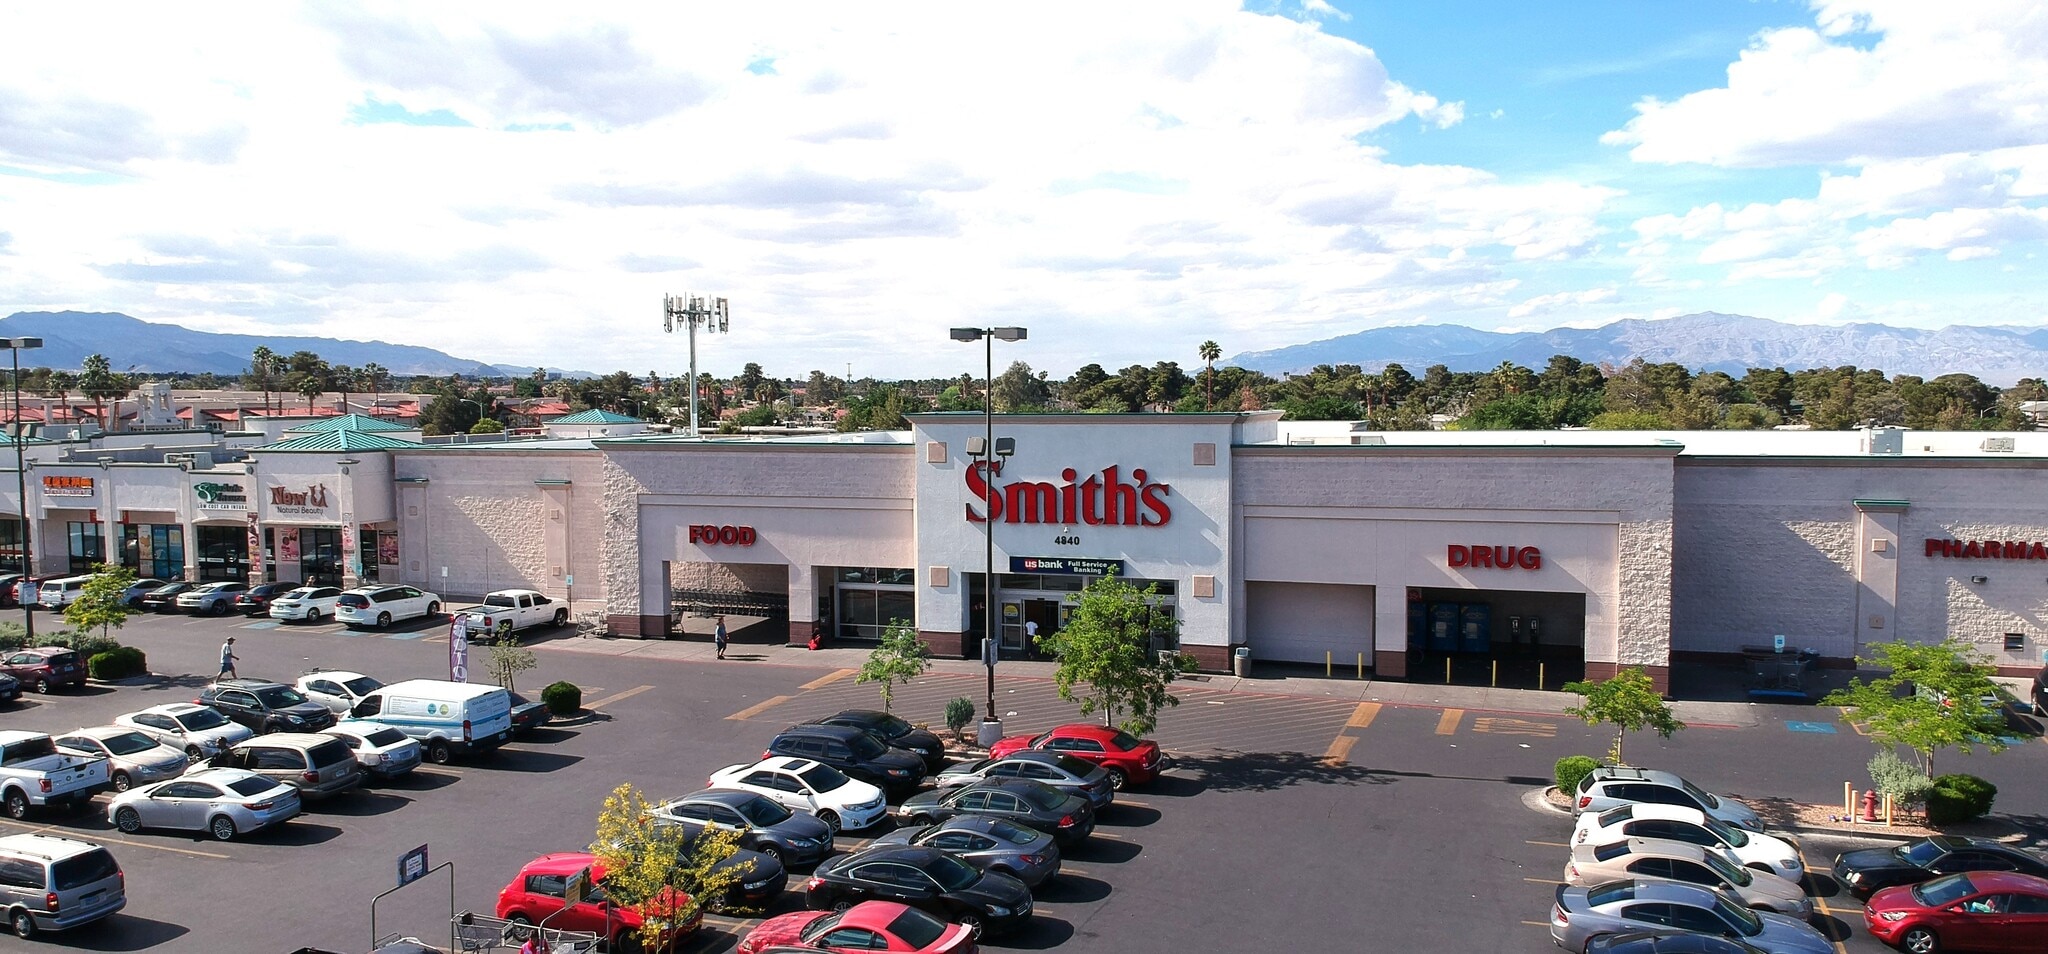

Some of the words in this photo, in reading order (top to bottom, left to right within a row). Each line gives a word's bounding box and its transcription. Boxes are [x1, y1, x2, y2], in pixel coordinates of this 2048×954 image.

[270, 486, 308, 506] New
[308, 483, 329, 508] U
[965, 460, 1172, 527] Smith's
[277, 506, 300, 514] Natural
[301, 506, 324, 516] Beauty
[688, 524, 757, 547] FOOD
[1054, 535, 1081, 546] 4840
[1447, 544, 1542, 571] DRUG
[1925, 538, 2048, 560] PHARMA
[1067, 560, 1081, 568] Full
[1081, 561, 1108, 569] Service
[1073, 566, 1102, 575] Banking
